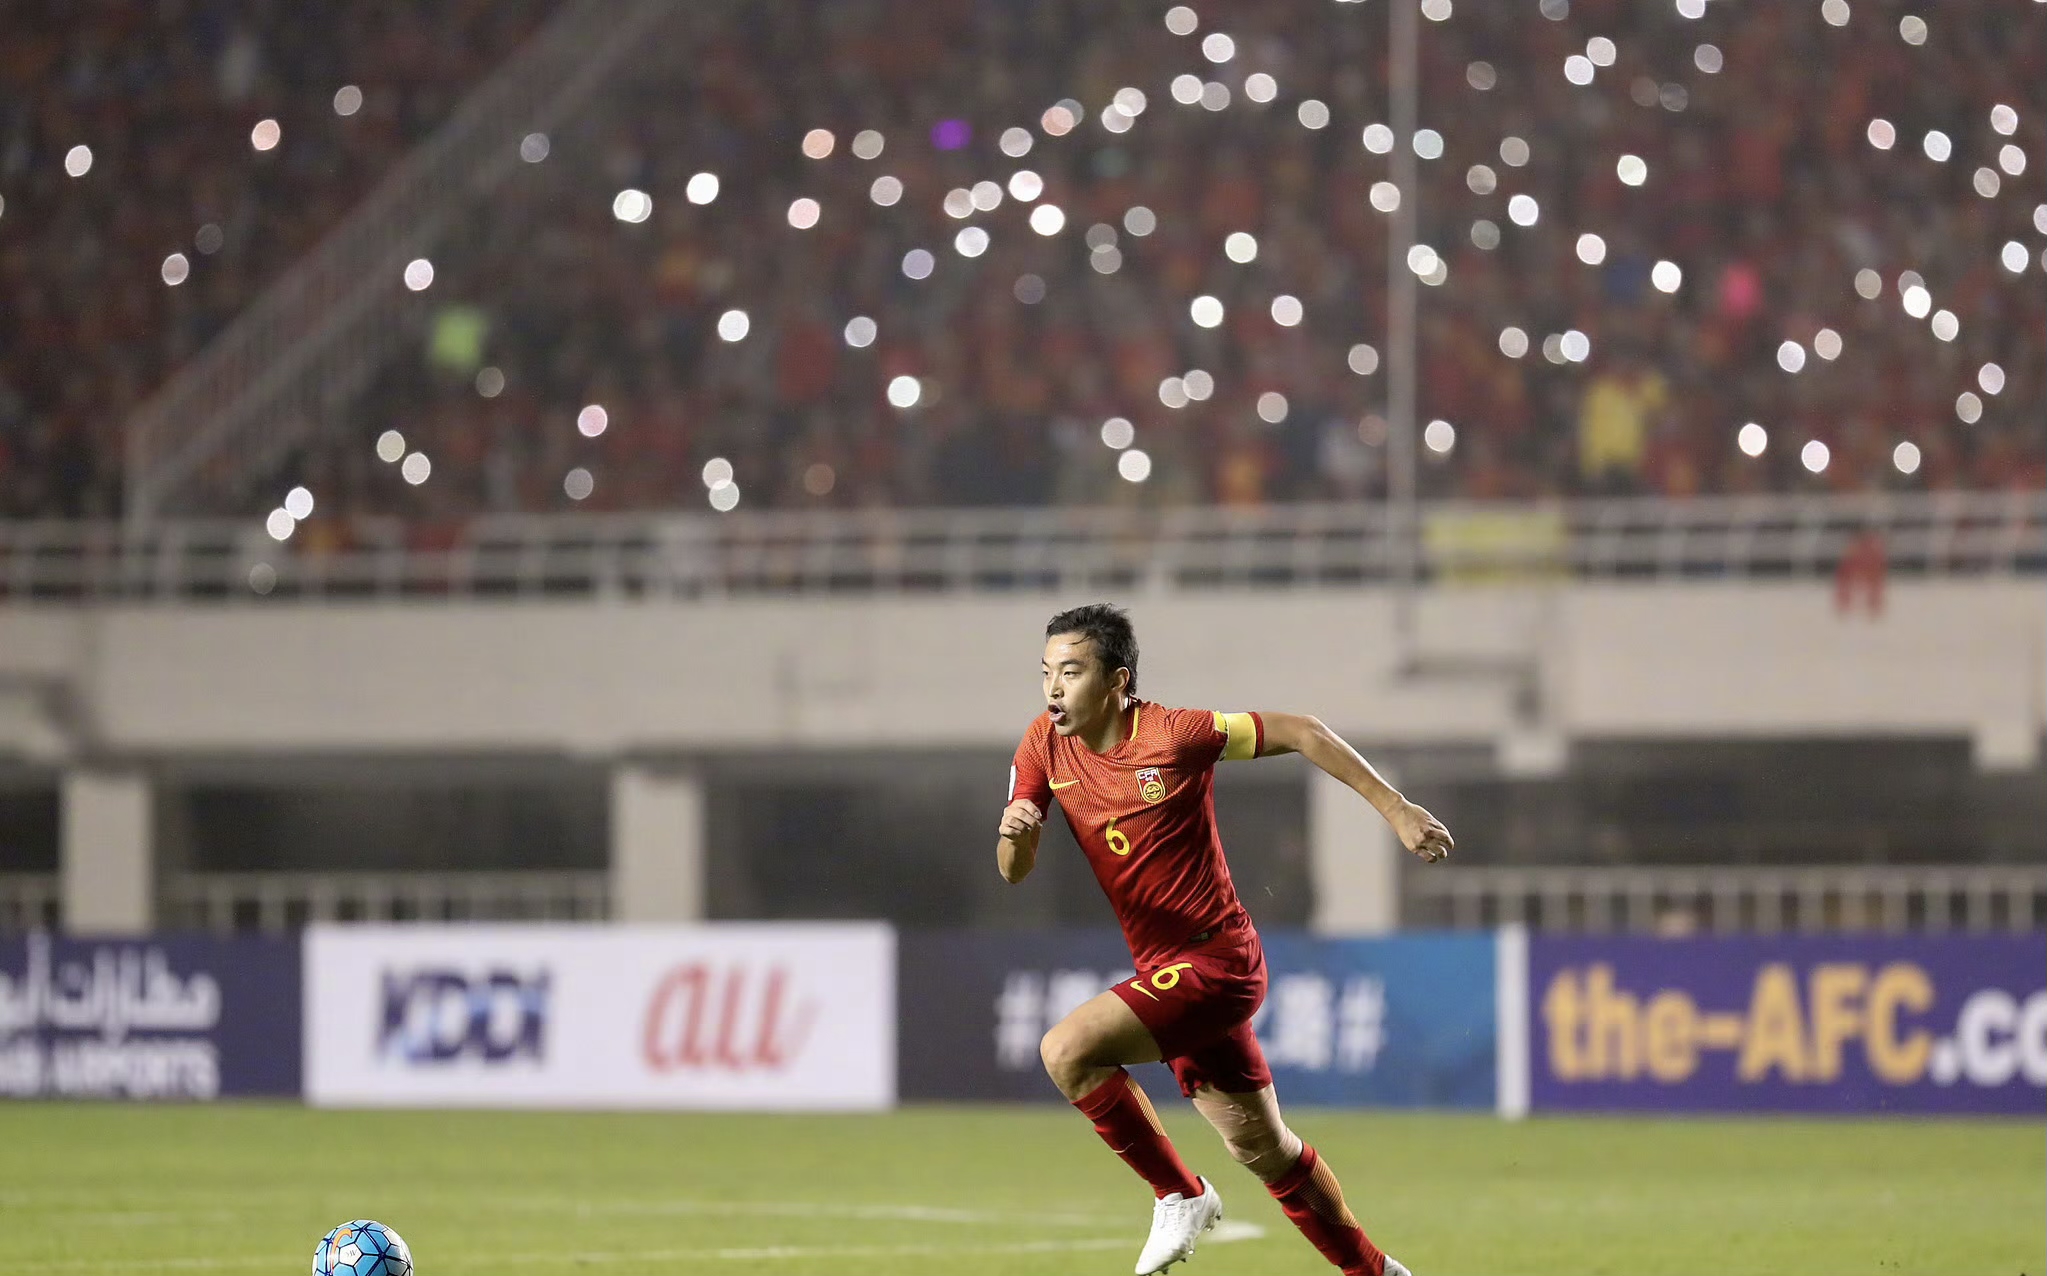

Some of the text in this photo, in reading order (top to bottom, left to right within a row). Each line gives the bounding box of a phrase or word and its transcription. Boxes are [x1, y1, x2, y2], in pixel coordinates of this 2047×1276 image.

[1106, 818, 1130, 856] 6
[1151, 962, 1193, 990] 6
[374, 963, 553, 1065] KDDI
